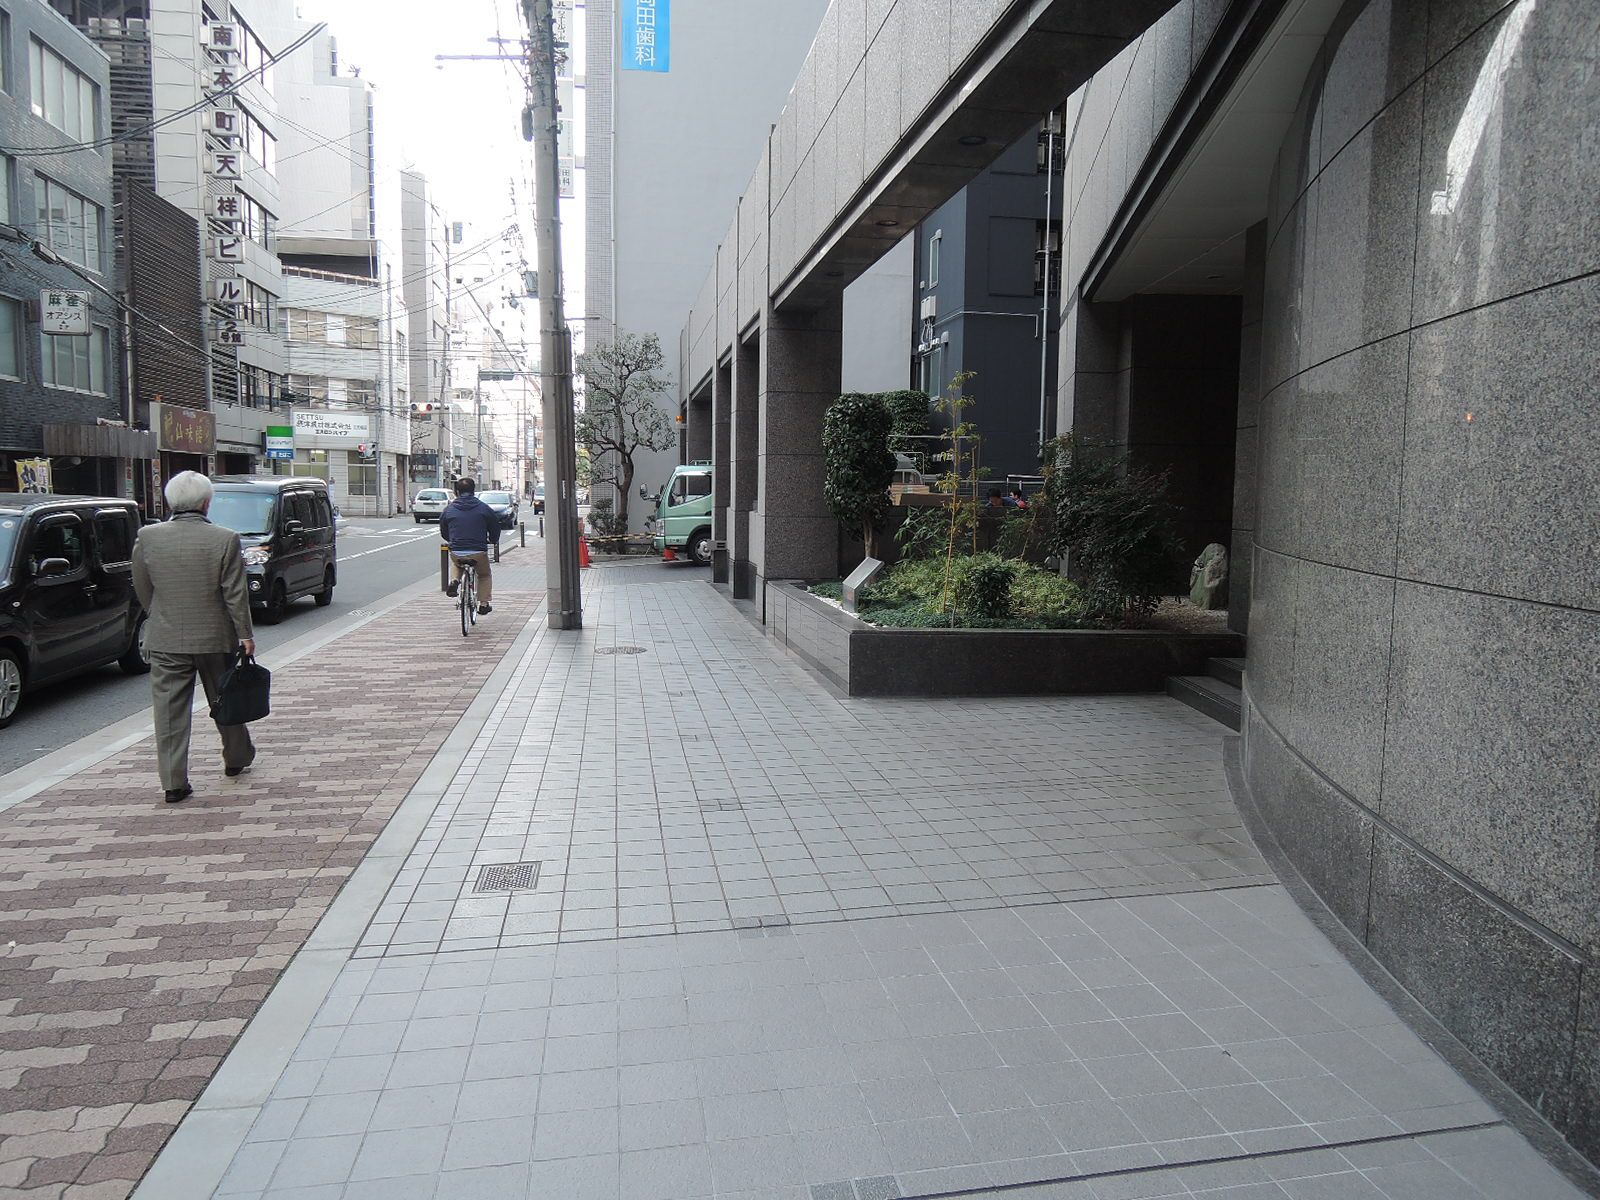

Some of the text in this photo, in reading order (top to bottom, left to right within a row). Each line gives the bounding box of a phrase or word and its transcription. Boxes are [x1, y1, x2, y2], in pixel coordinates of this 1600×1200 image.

[212, 25, 241, 300] 南本町天祥ビル
[48, 292, 81, 307] 麻雀
[46, 310, 82, 321] オアシス
[296, 413, 324, 421] SETTSU
